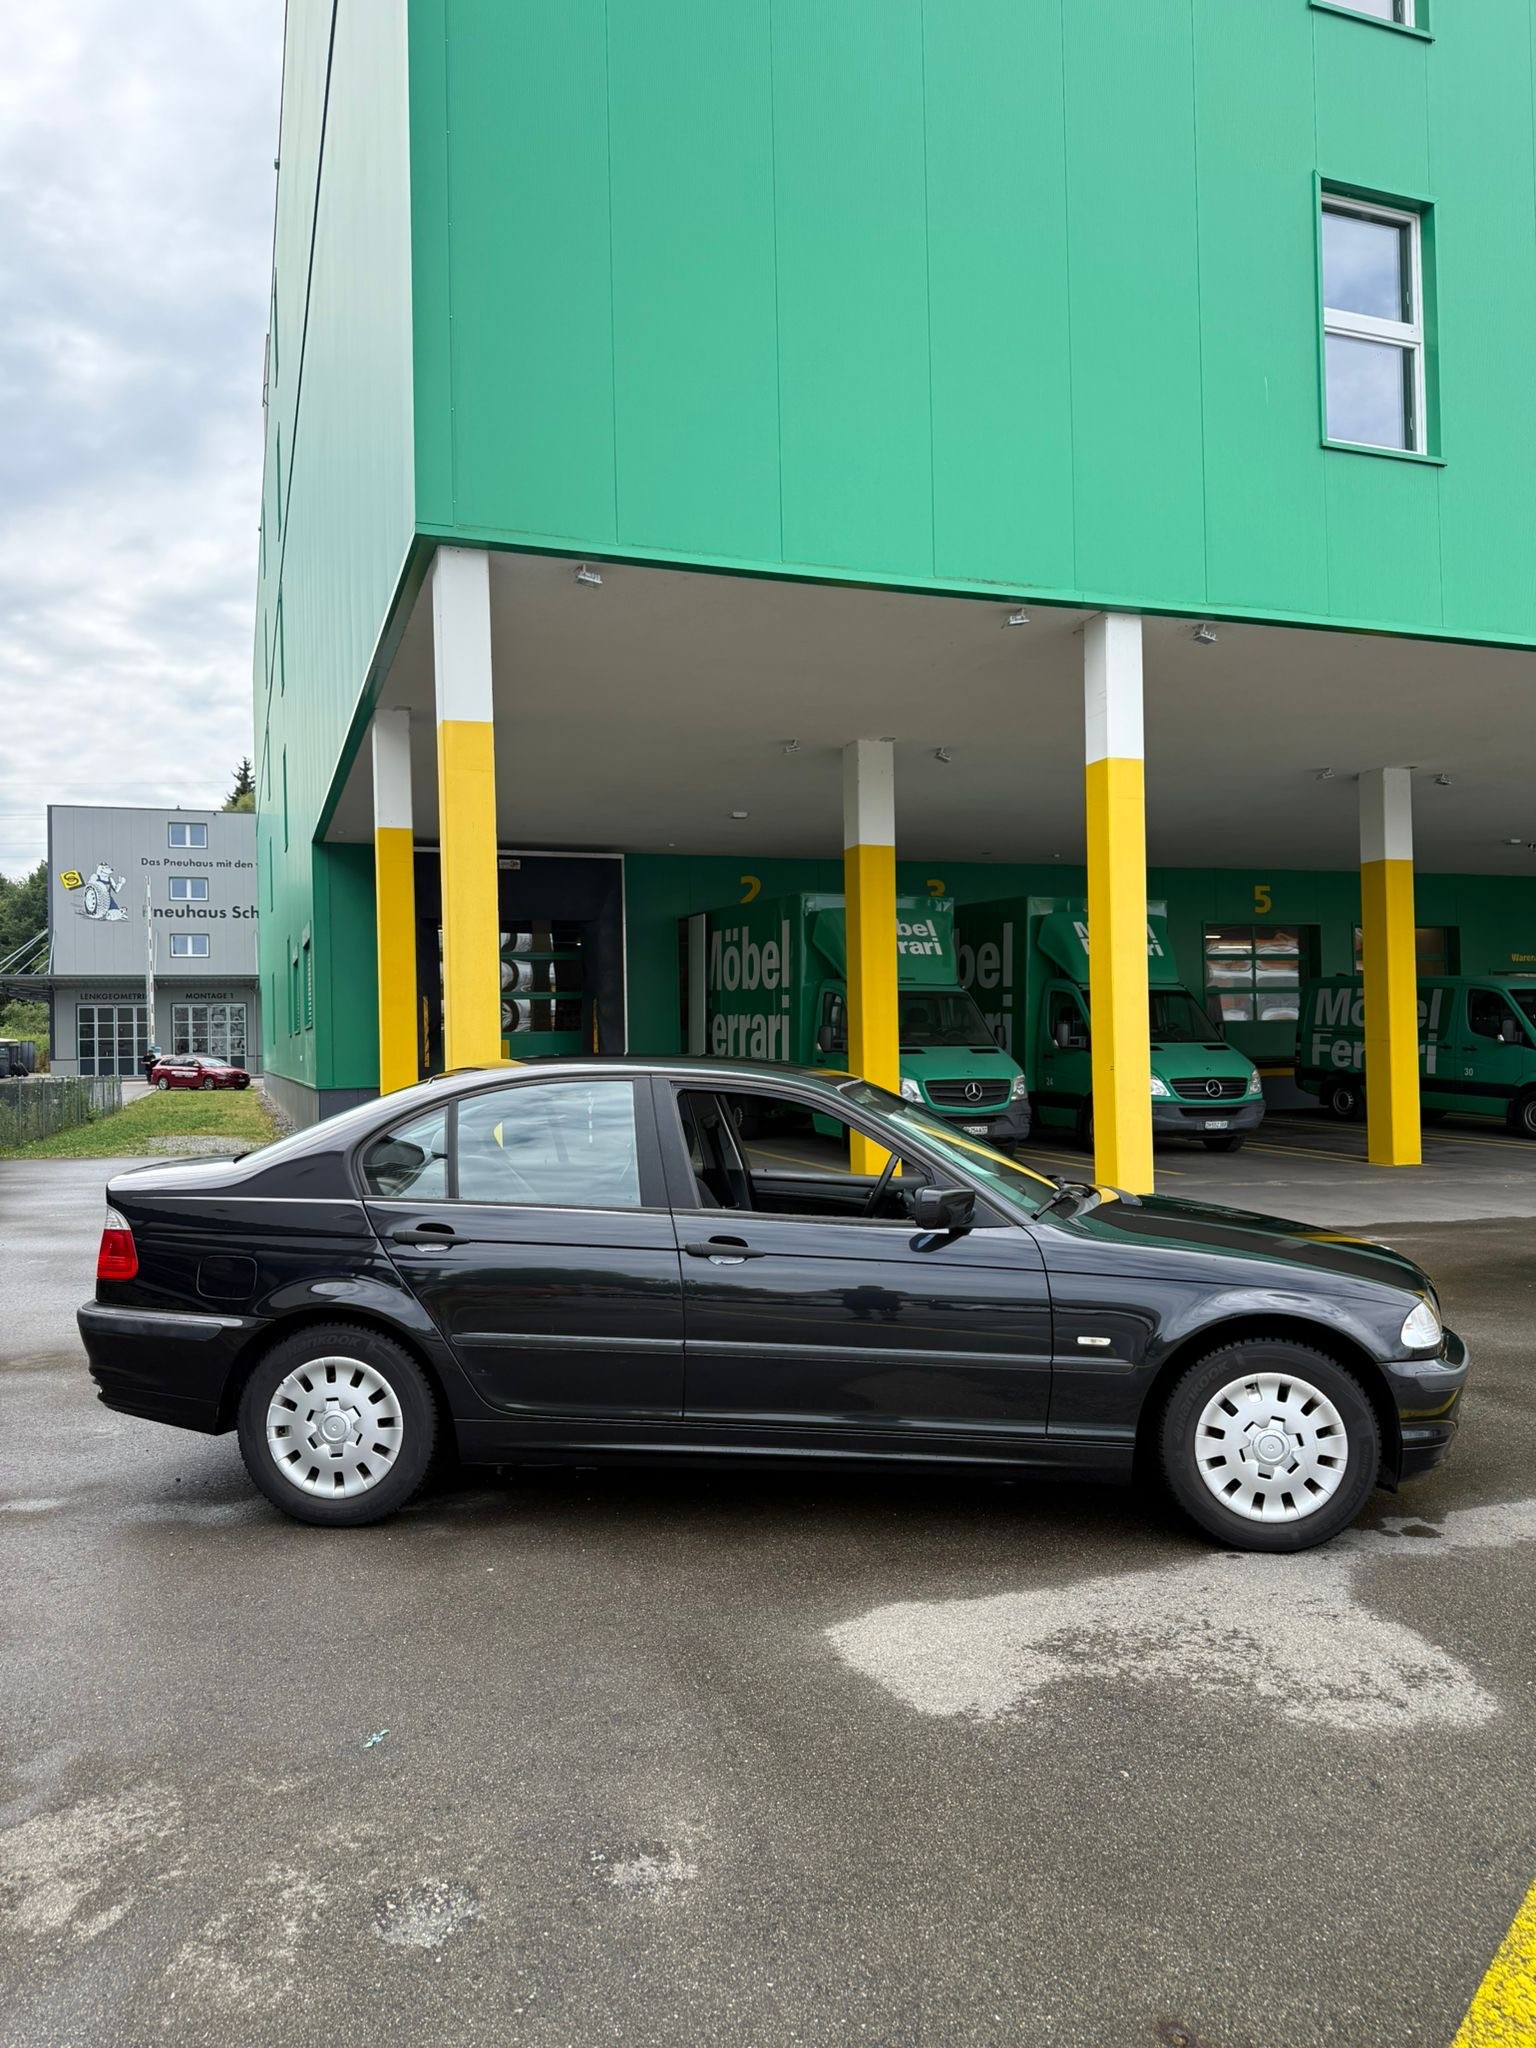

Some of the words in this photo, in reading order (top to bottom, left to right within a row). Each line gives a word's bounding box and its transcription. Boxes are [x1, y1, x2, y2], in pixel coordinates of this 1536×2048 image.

[141, 858, 161, 867] Das
[164, 859, 214, 868] Pneuhaus
[216, 860, 231, 868] mit
[234, 860, 254, 869] den
[1254, 885, 1272, 914] 5
[896, 918, 937, 937] bel
[897, 938, 943, 955] rari
[952, 921, 1014, 990] bel
[708, 994, 790, 1061] errari
[1464, 1067, 1474, 1077] 30
